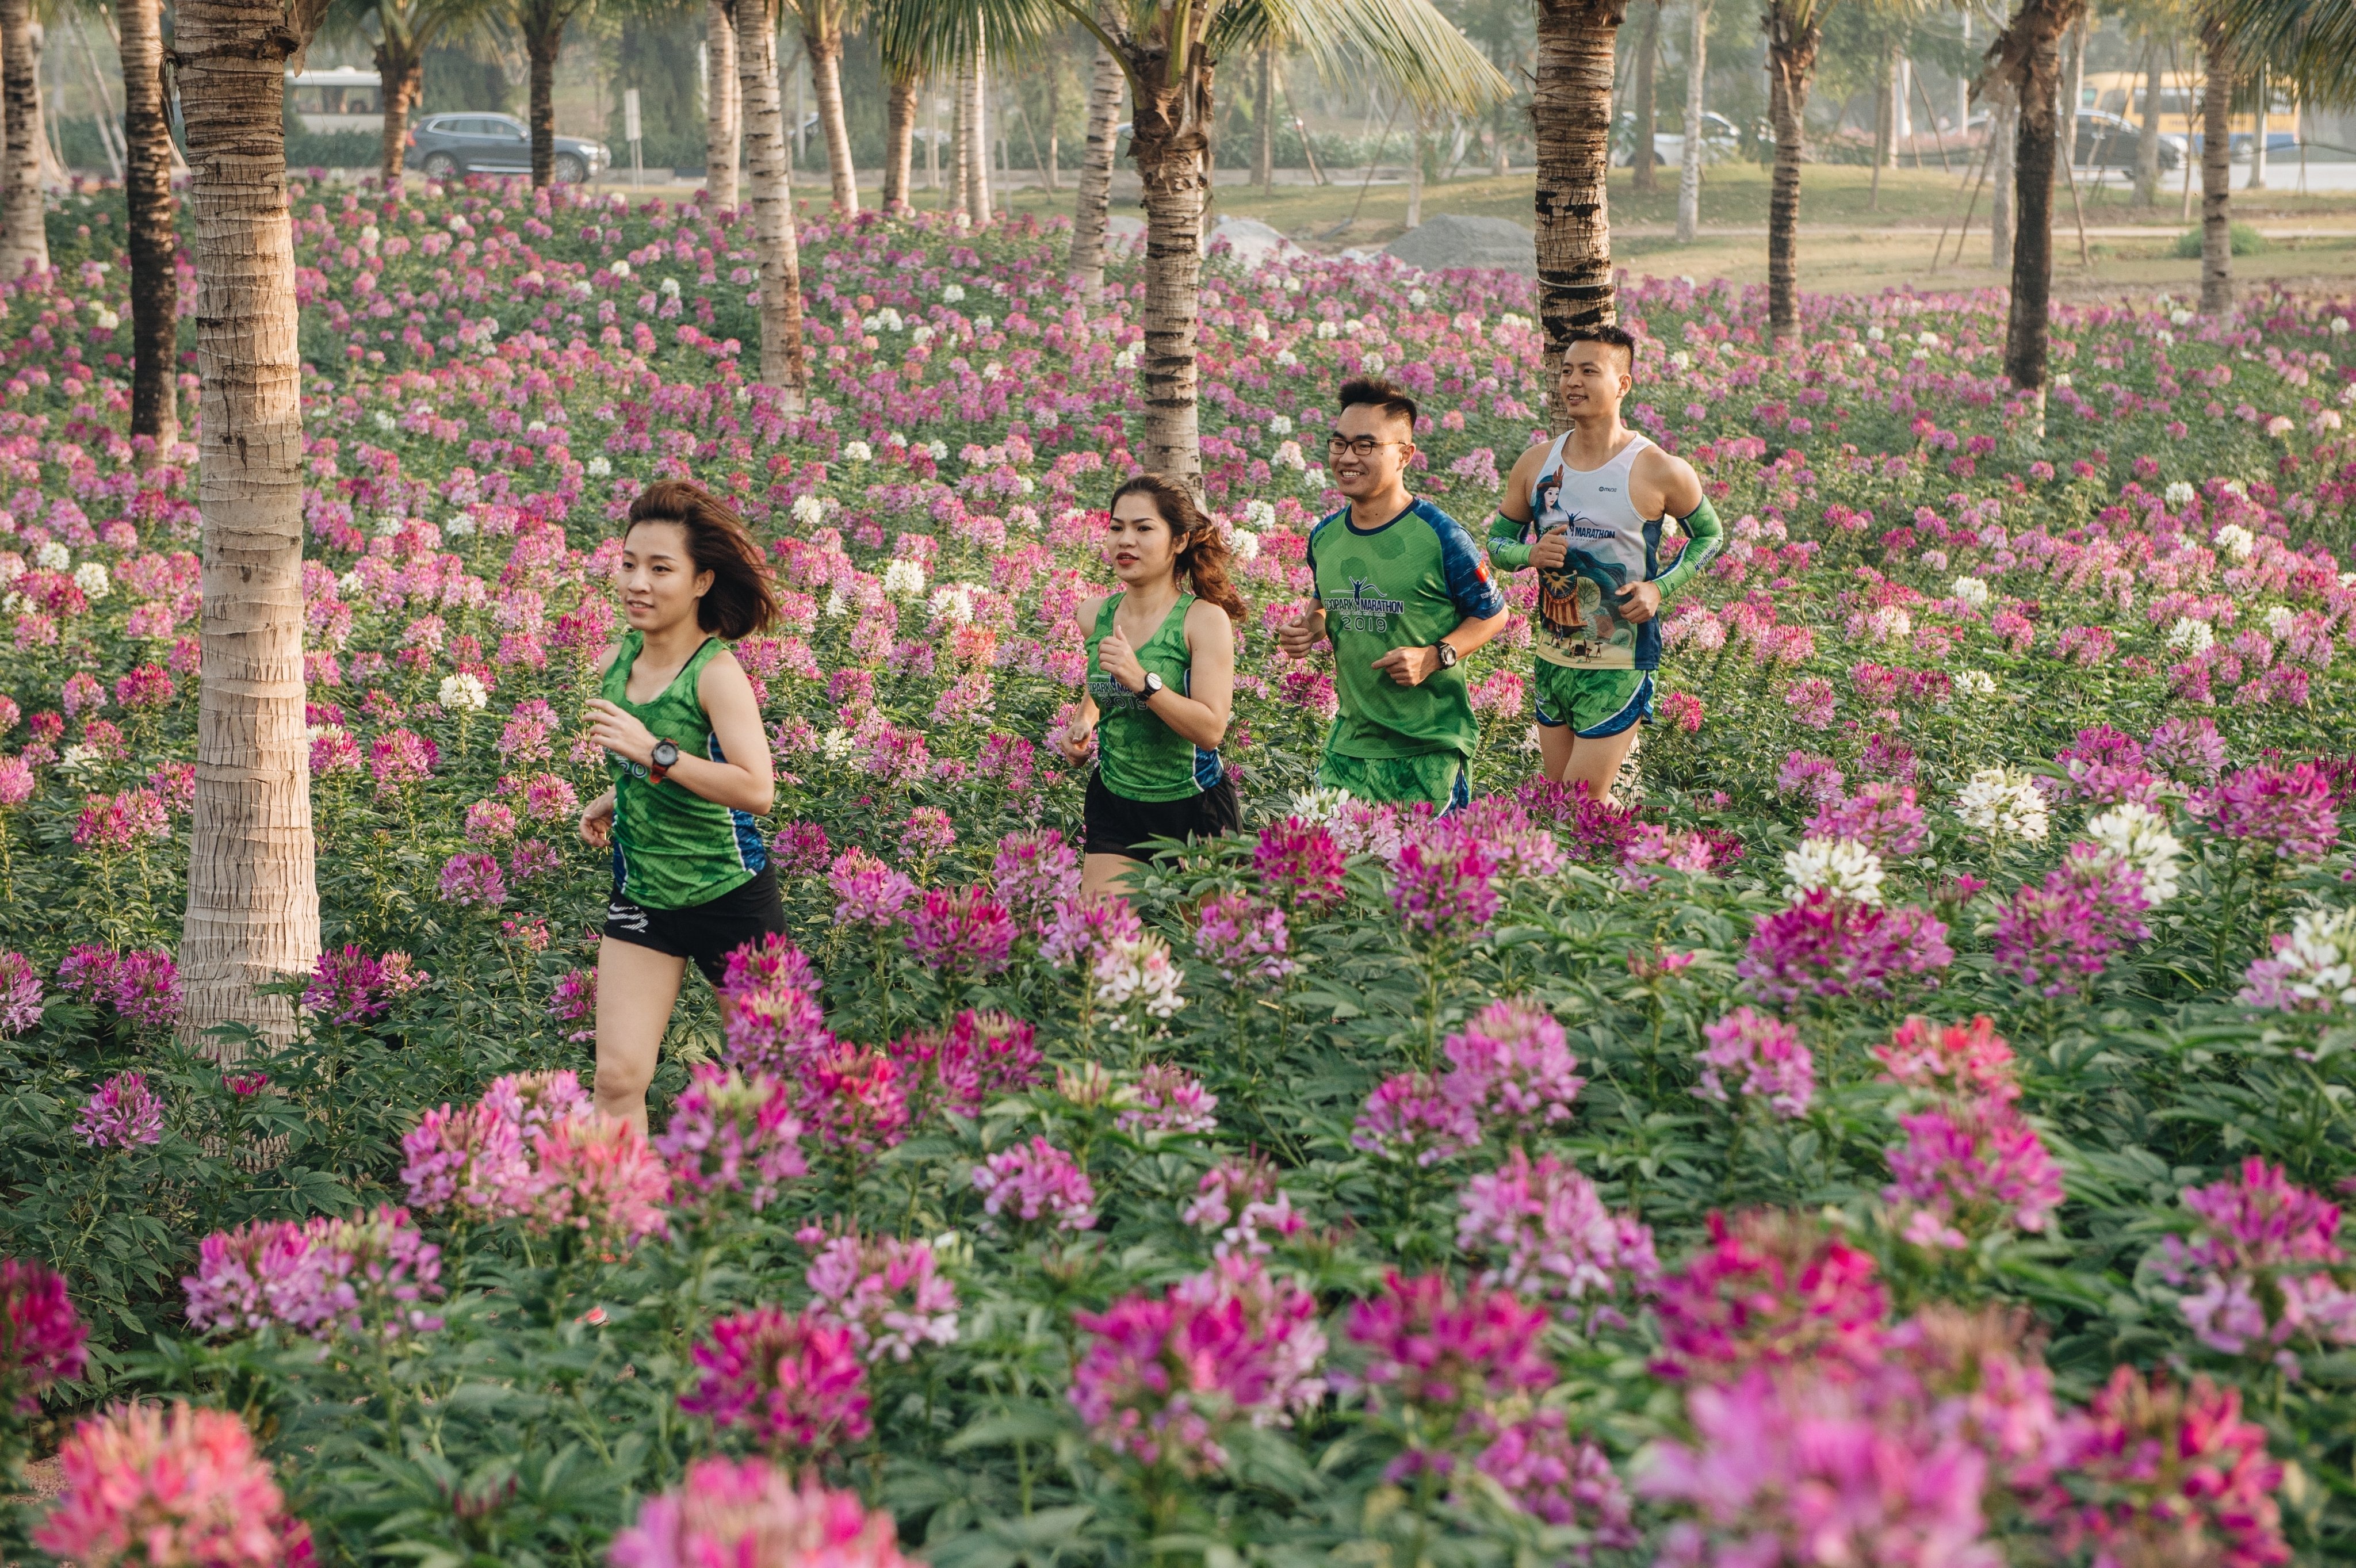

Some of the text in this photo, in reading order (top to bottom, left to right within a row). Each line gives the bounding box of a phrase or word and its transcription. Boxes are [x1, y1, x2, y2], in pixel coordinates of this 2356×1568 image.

[1575, 527, 1616, 539] MARATHON
[1324, 598, 1405, 614] ECOPARK MARATHON
[1341, 616, 1387, 632] 2019
[1101, 697, 1148, 709] 2019
